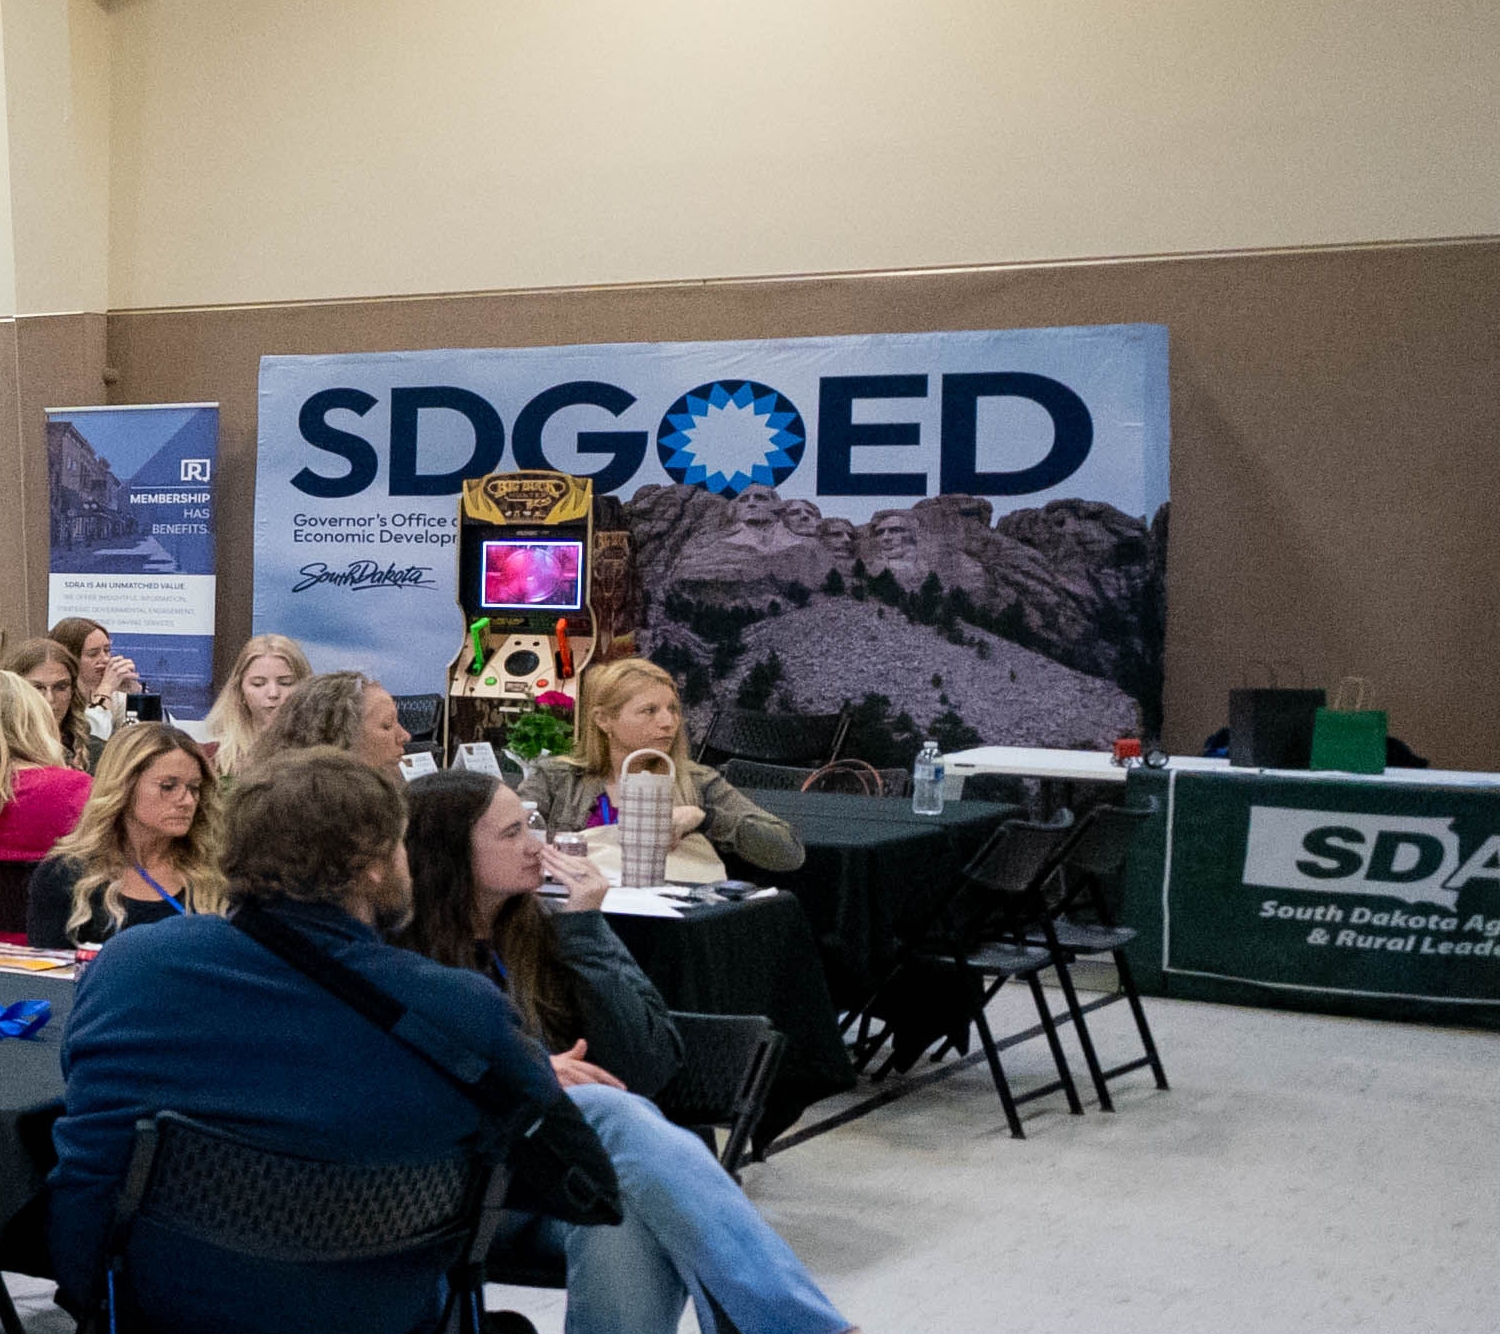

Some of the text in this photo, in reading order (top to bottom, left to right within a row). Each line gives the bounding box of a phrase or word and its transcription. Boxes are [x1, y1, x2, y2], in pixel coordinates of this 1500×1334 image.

[130, 494, 210, 504] MEMBERSHIP
[184, 508, 210, 518] HAS
[293, 513, 387, 527] Governor's
[391, 513, 447, 527] Office
[152, 524, 210, 534] BENEFITS.
[293, 529, 457, 547] Economic Develop
[1259, 900, 1344, 922] South
[1350, 907, 1459, 931] Dakota
[1306, 928, 1330, 945] &
[1336, 930, 1417, 952] Rural
